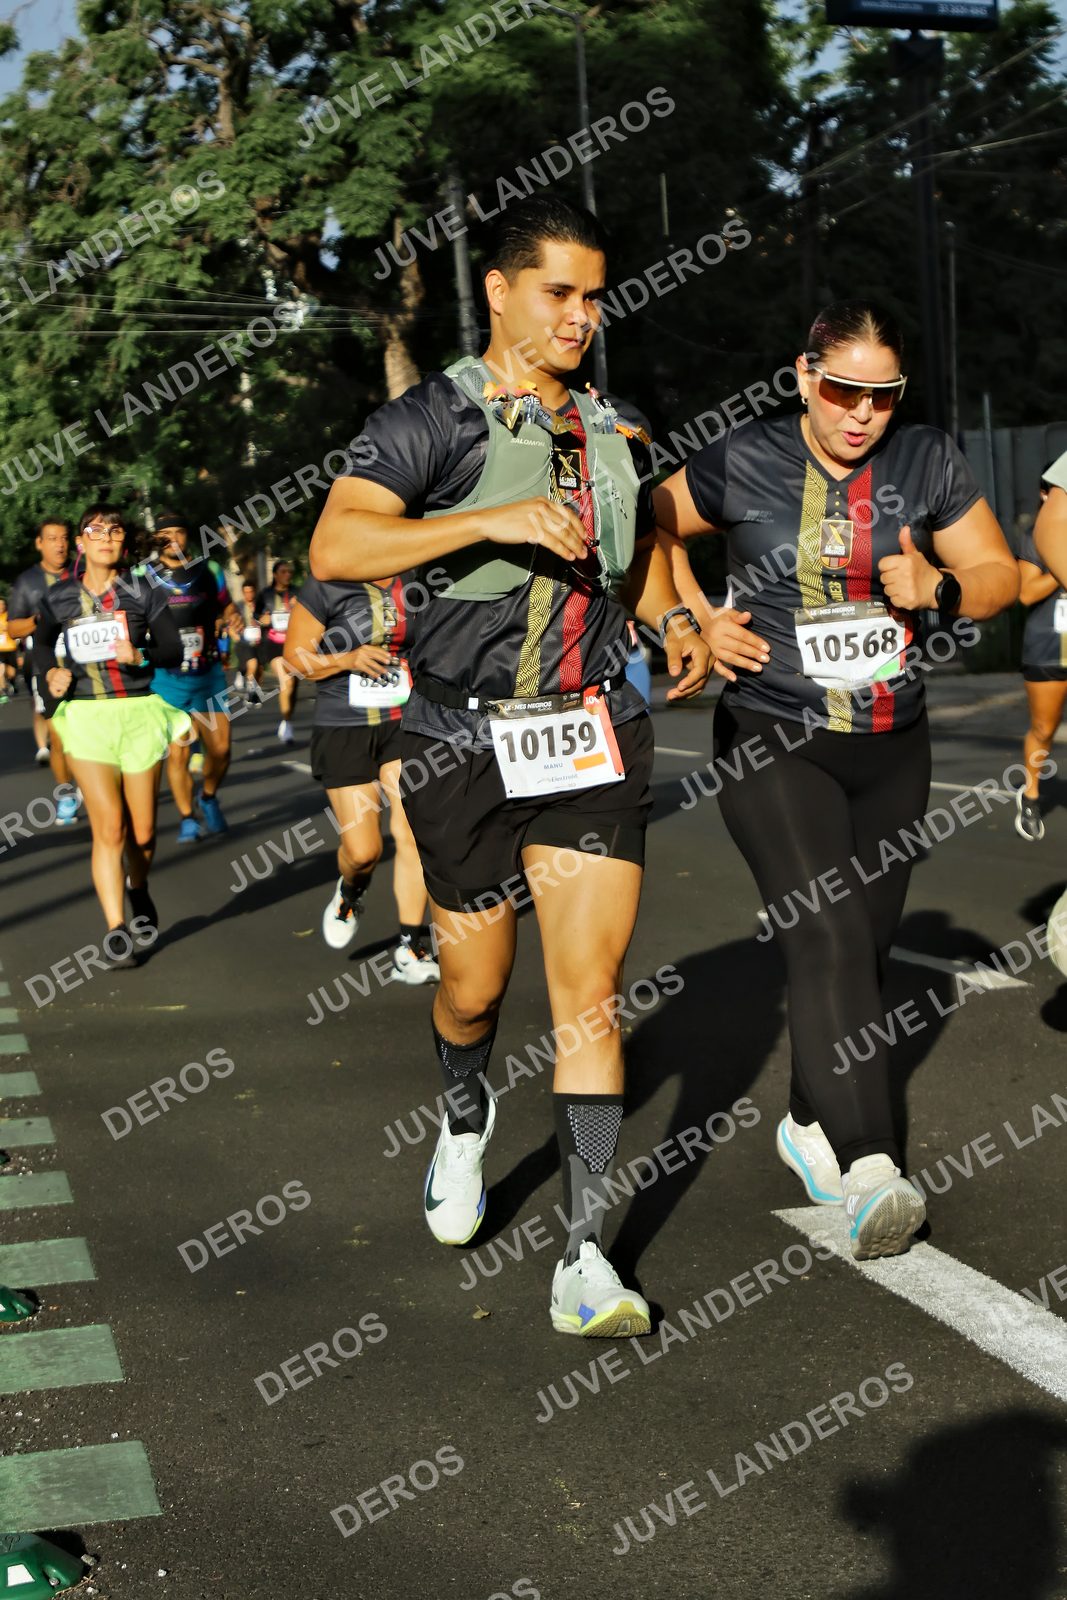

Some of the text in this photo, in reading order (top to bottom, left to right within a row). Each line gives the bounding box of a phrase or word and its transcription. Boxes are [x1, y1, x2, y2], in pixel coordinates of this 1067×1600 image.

[510, 437, 546, 447] SALOMON
[72, 626, 120, 647] 10029
[804, 627, 898, 662] 10568
[500, 721, 597, 762] 10159
